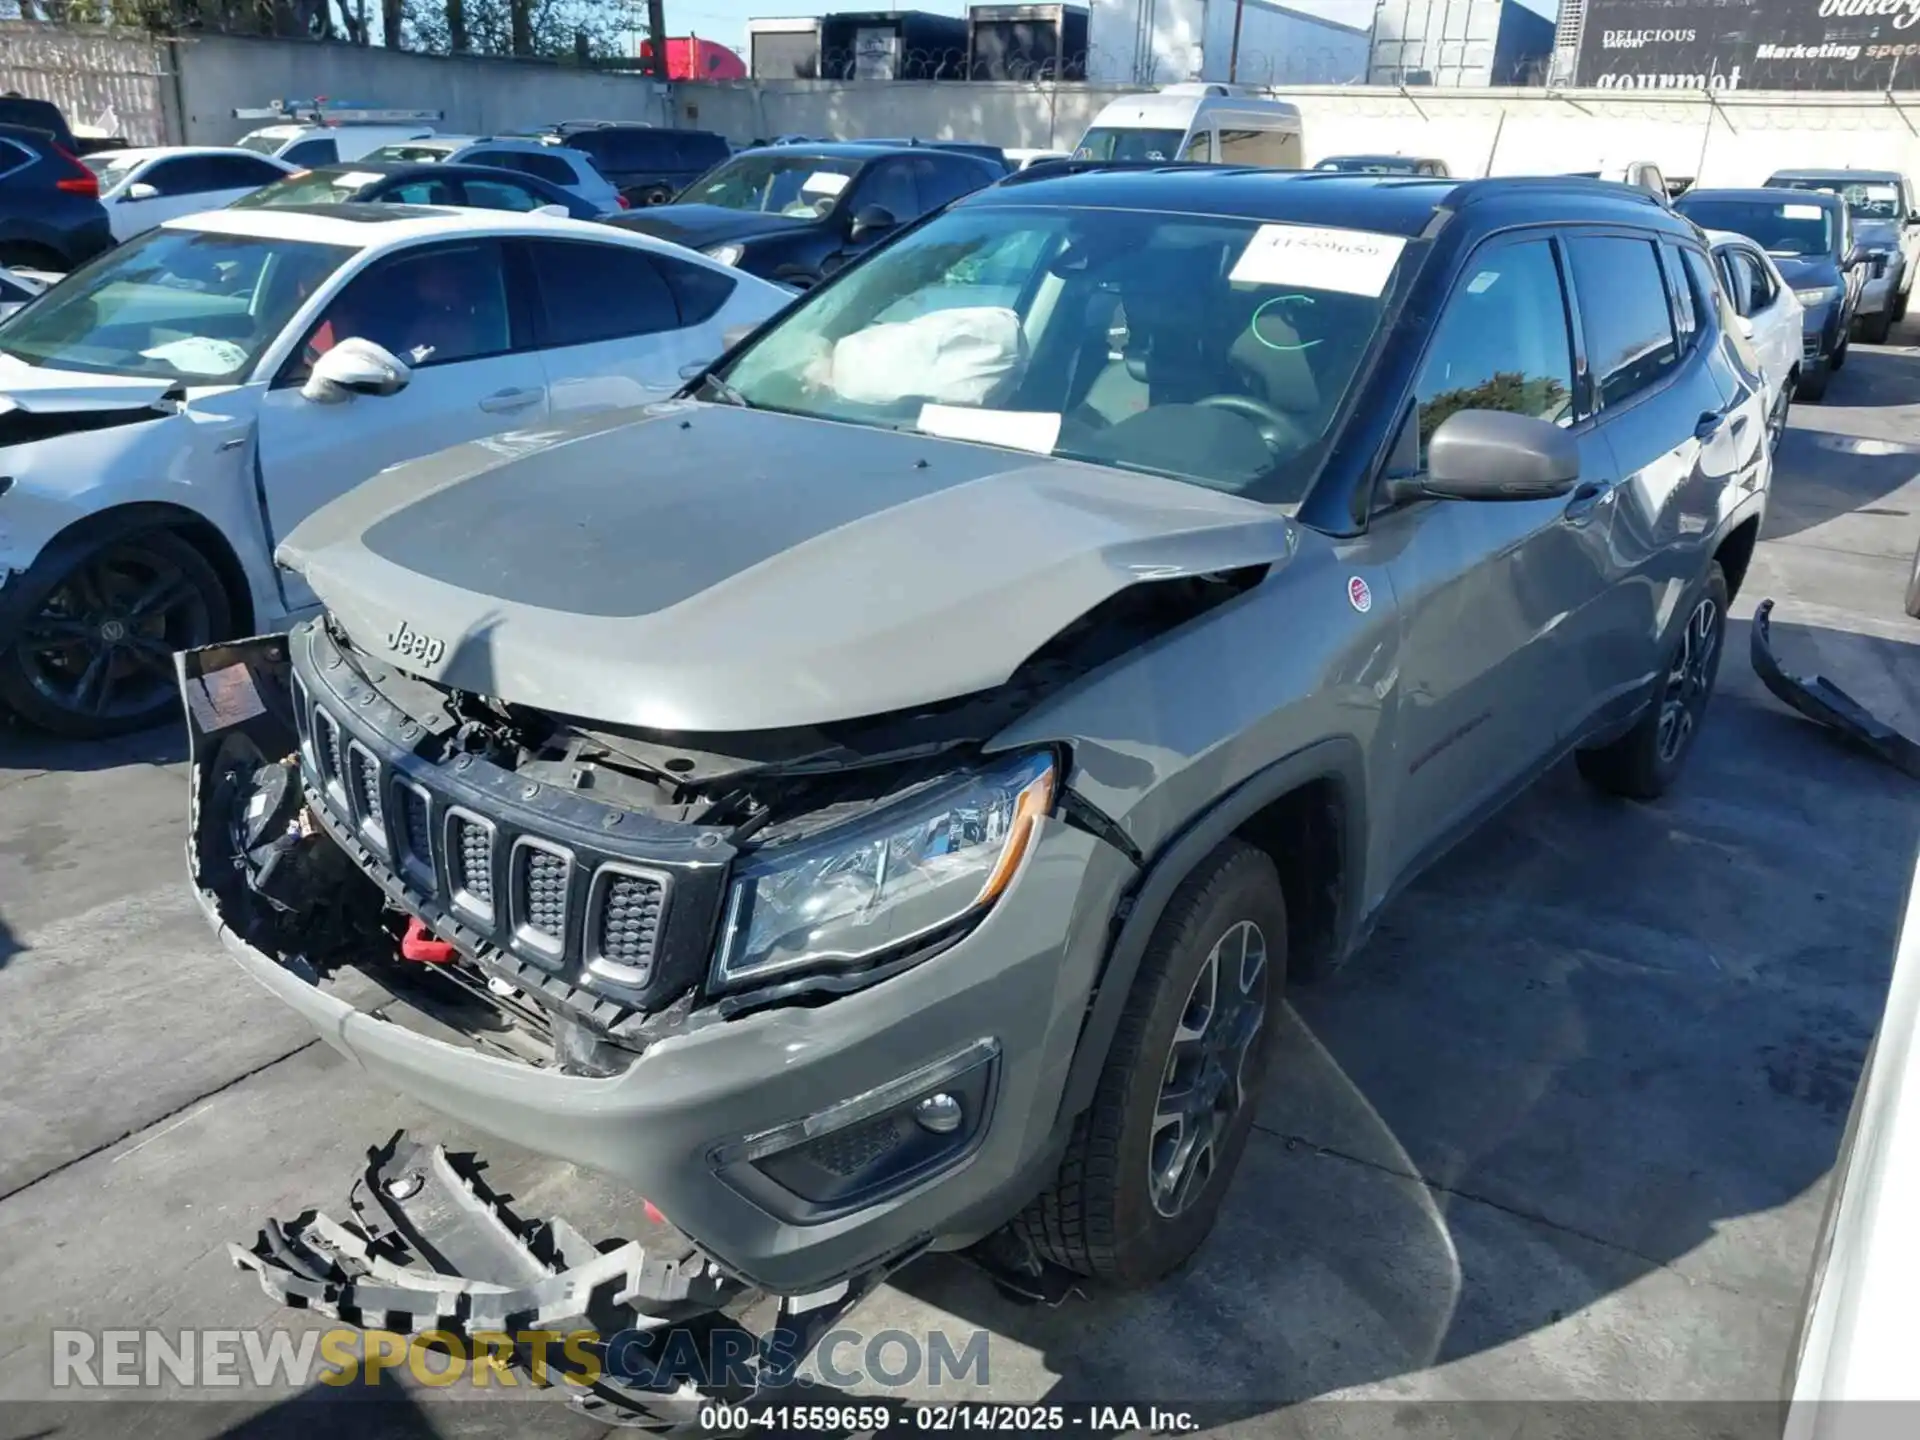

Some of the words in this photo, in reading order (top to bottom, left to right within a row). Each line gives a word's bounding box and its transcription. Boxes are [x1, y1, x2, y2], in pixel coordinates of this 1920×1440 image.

[1603, 29, 1697, 42] DELICIOUS
[1756, 43, 1861, 61] Marketing
[1865, 43, 1920, 59] spec
[387, 620, 447, 669] Jeep
